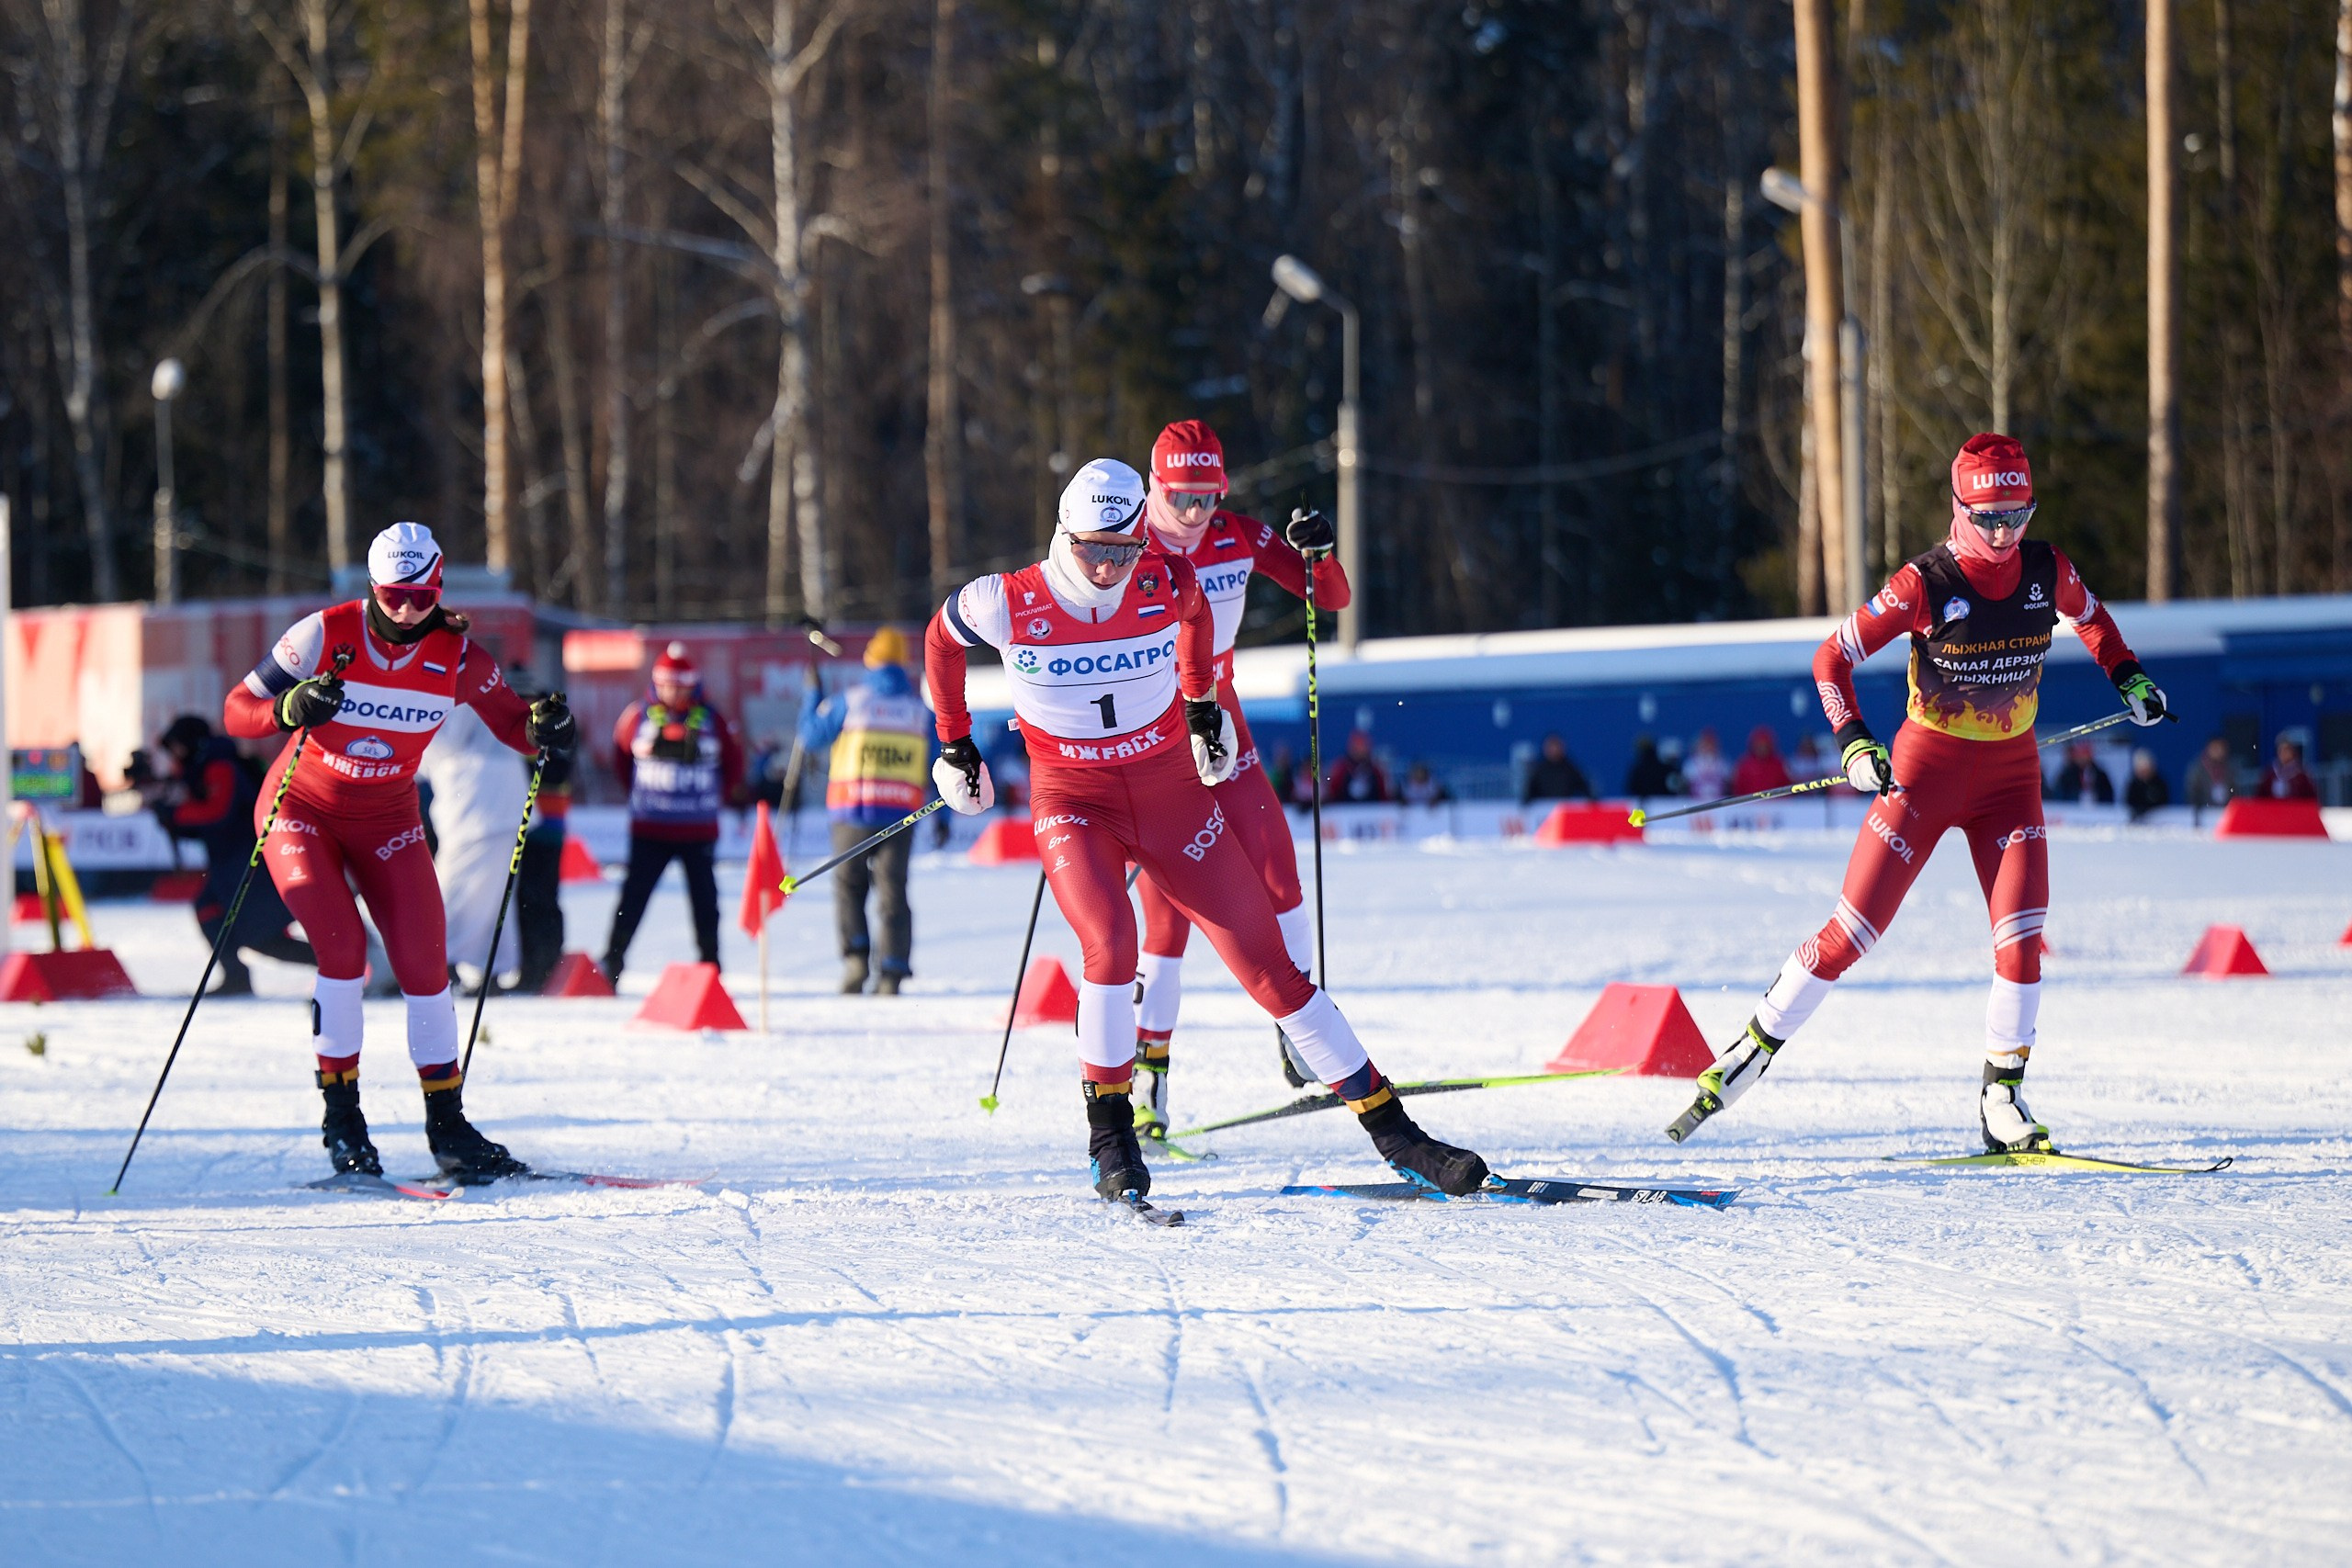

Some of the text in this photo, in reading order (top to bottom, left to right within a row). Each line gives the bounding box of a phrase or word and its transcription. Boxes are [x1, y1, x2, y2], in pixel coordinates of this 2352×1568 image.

[1167, 453, 1221, 468] LUKOIL
[1973, 471, 2029, 491] LUKOIL
[1091, 495, 1132, 507] LUKOIL
[388, 551, 425, 560] LUKOIL
[1204, 570, 1247, 593] АГРО
[1015, 603, 1053, 619] РУСКЛИМАТ
[2024, 601, 2049, 610] ФОСАГРО
[280, 634, 300, 666] SCO
[1941, 632, 2051, 655] ЛЫЖНАЯ СТРАНА
[1047, 640, 1175, 676] ФОСАГРО
[1933, 651, 2048, 671] САМАЯ ДЕРЗКА
[1951, 669, 2031, 684] ЛЫЖНИЦА
[340, 698, 444, 723] ФОСАГРО
[1091, 694, 1118, 729] 1
[322, 750, 403, 779] ИЖЕВСК
[1034, 814, 1089, 837] LUKOIL
[1867, 812, 1915, 864] LUKOIL
[2004, 1156, 2046, 1166] FISCHER
